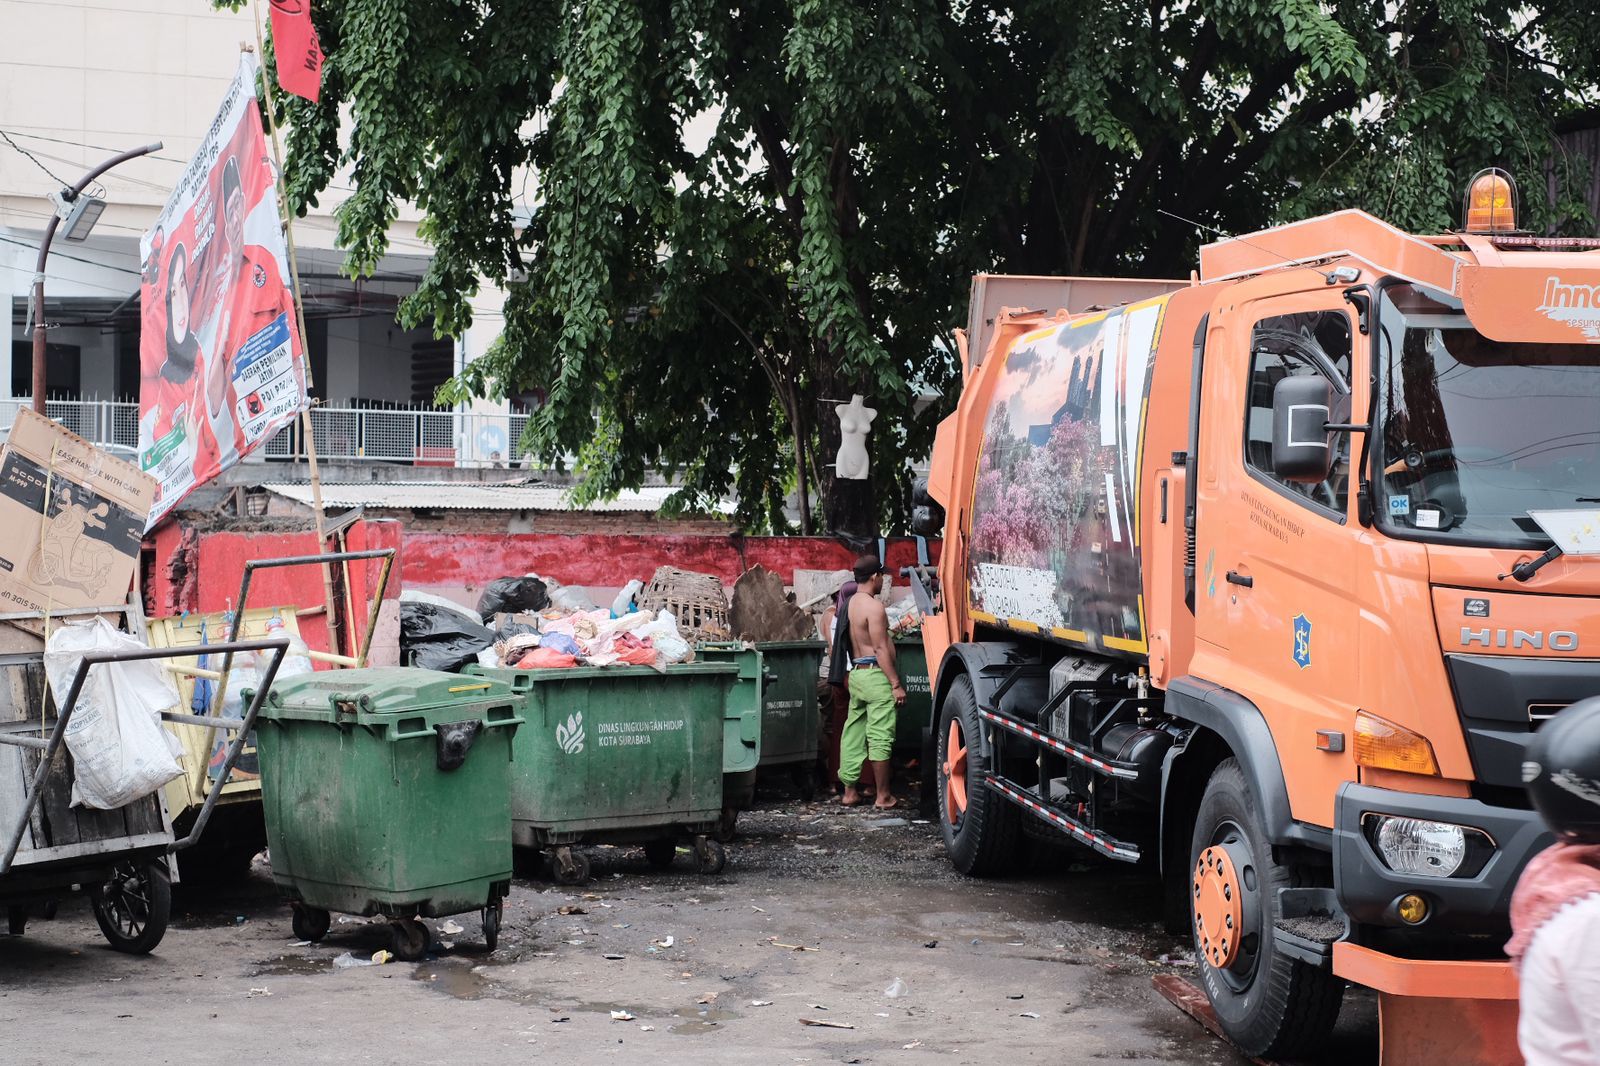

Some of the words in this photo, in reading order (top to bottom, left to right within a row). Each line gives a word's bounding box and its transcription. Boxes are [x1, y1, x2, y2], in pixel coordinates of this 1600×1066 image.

[104, 472, 122, 489] WITH
[122, 481, 142, 497] CARE
[1391, 499, 1408, 508] OK
[1, 590, 11, 598] UP
[11, 593, 30, 607] SIDE
[1461, 627, 1579, 651] HINO
[598, 723, 620, 734] DINAS
[620, 721, 663, 732] LINGKUNGAN
[663, 720, 684, 731] HIDUP
[599, 736, 618, 747] KOTA
[619, 735, 651, 746] SURABAYA
